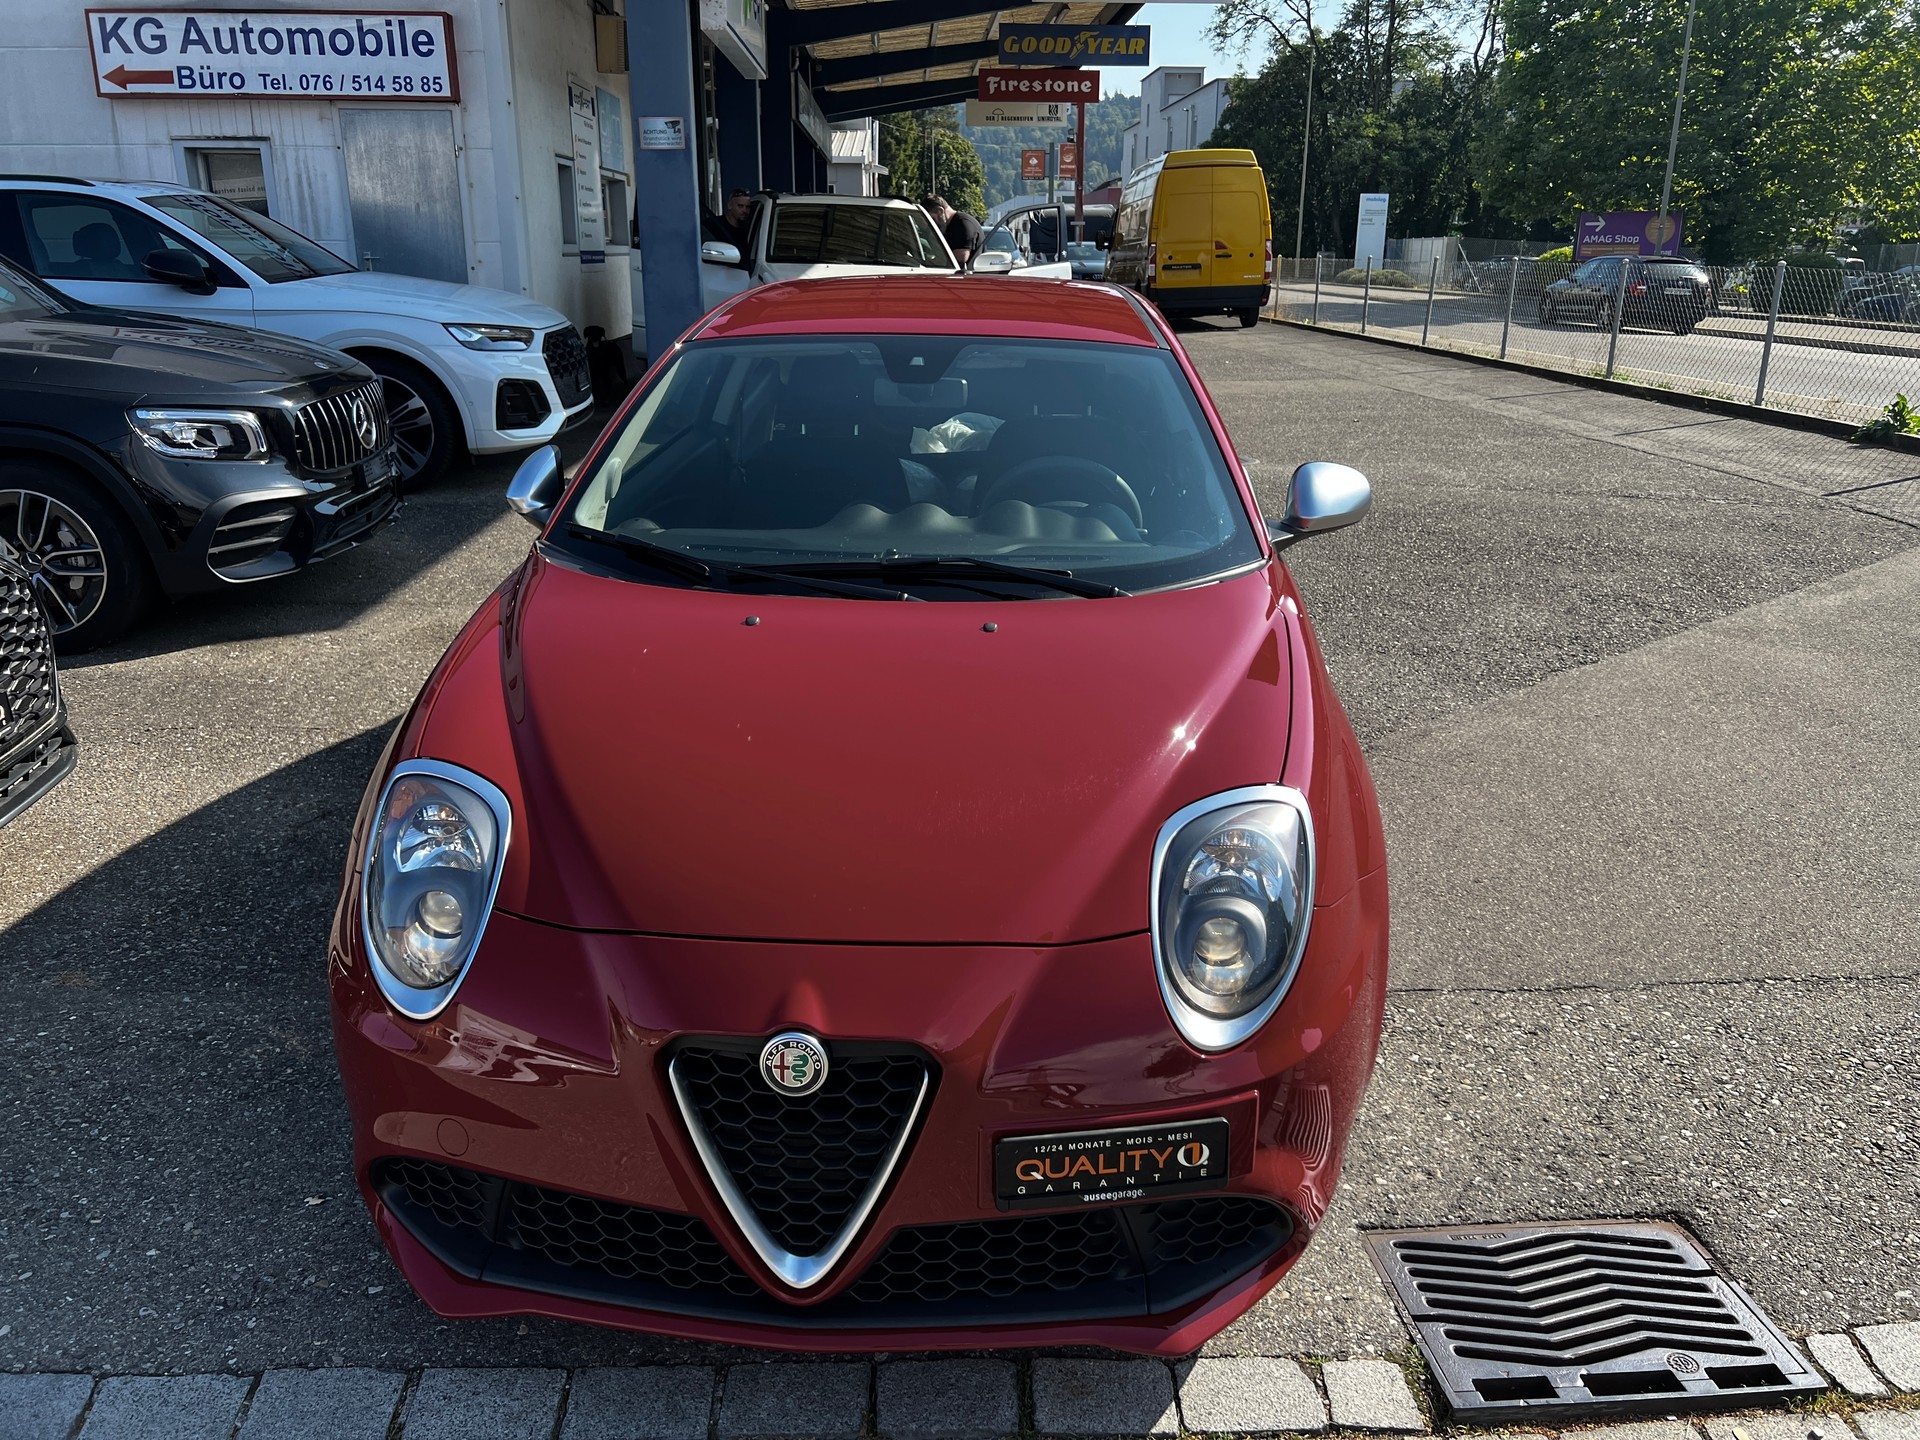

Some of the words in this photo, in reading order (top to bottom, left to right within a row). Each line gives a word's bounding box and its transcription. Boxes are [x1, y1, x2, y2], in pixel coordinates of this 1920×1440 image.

[97, 16, 167, 55] KG
[179, 16, 436, 58] Automobile
[176, 65, 246, 90] Büro
[258, 73, 292, 91] Tel.
[299, 74, 334, 92] 076
[351, 74, 385, 92] 514
[391, 75, 415, 93] 58
[420, 75, 443, 94] 85
[985, 76, 1092, 95] Firestone
[1583, 235, 1612, 243] AMAG
[1614, 234, 1640, 244] Shop
[765, 1044, 785, 1067] ALFA
[789, 1041, 821, 1070] ROMEO
[1034, 1144, 1063, 1153] 12/24
[1068, 1140, 1112, 1150] MONATE
[1126, 1136, 1153, 1146] MOIS
[1167, 1132, 1193, 1141] MESI
[1015, 1146, 1174, 1181] QUALITY
[1017, 1168, 1208, 1194] GARANTIE
[1083, 1188, 1146, 1202] auseegarage.
